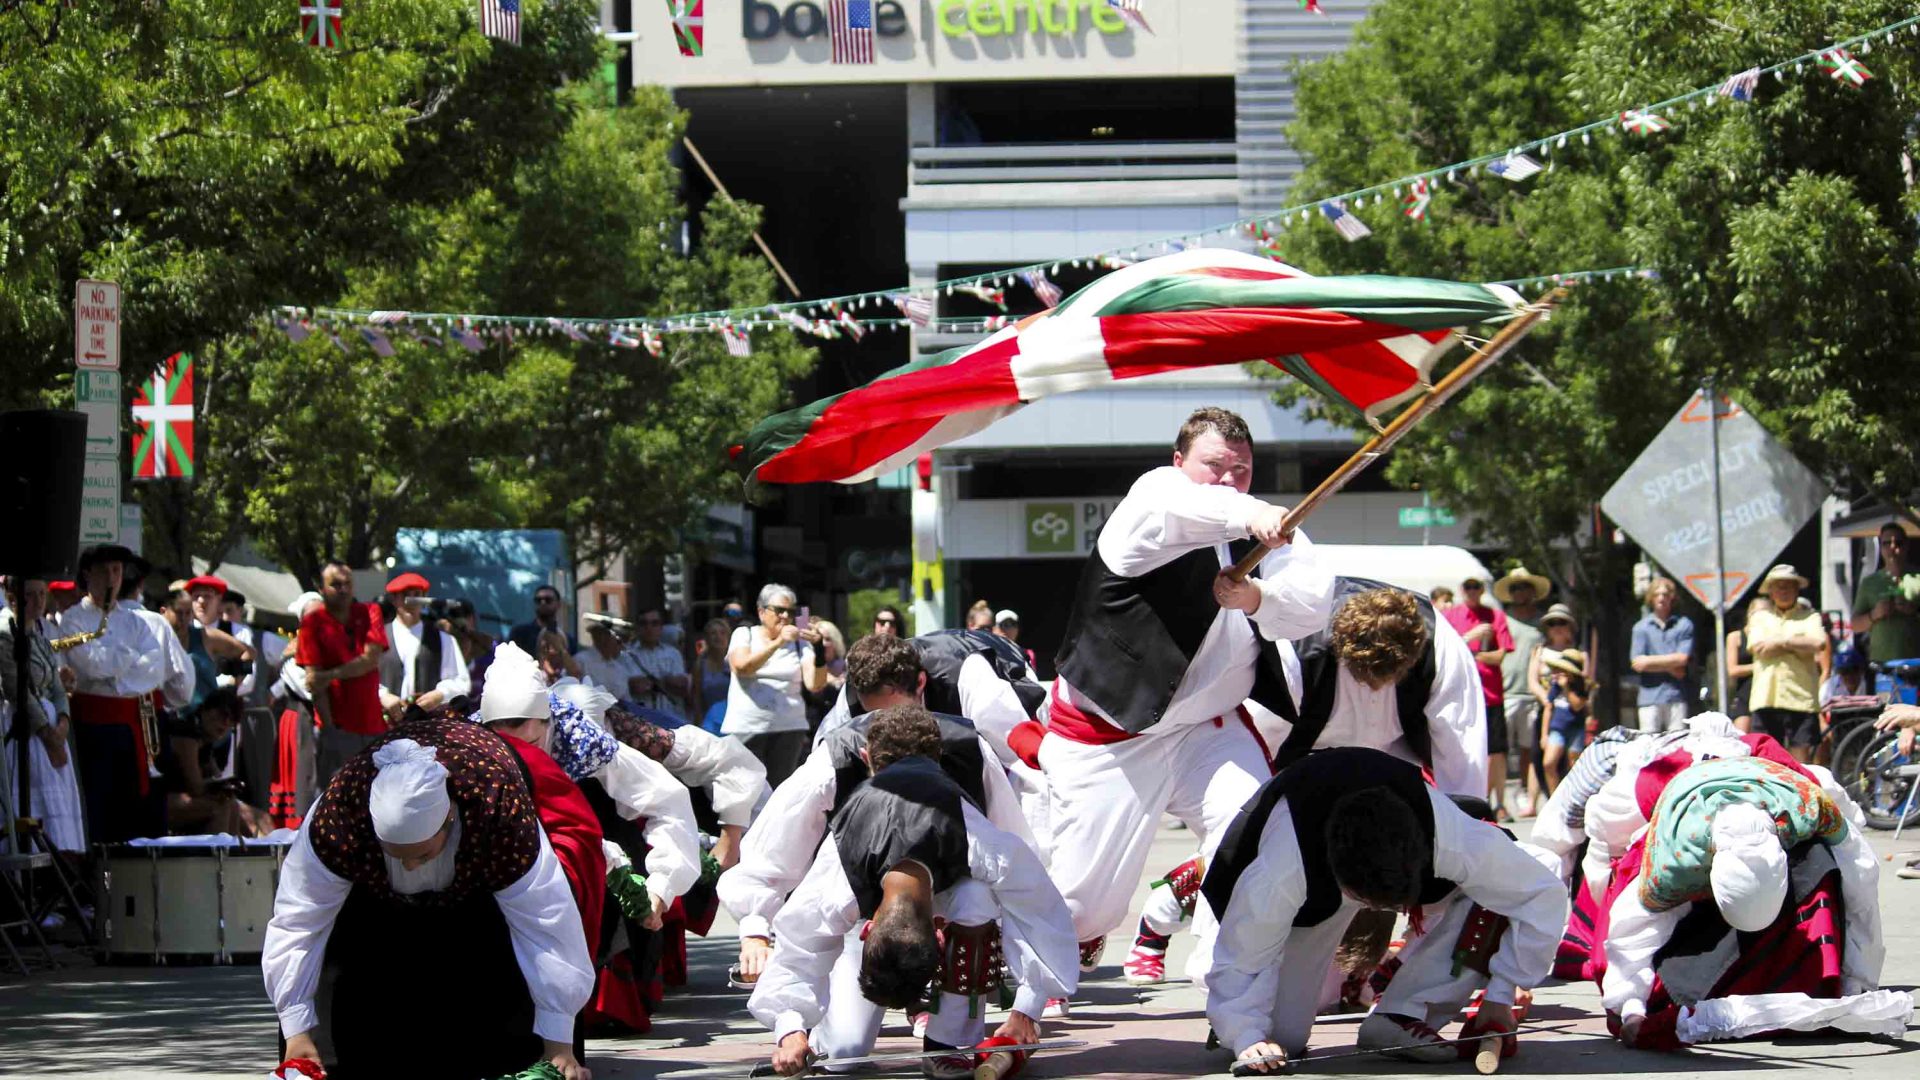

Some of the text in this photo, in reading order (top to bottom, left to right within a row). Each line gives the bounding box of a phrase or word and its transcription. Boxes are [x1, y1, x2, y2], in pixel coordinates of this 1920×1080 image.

[742, 0, 1126, 40] boe centre
[91, 289, 105, 304] NO
[80, 306, 115, 322] PARKING
[91, 323, 105, 335] ANY
[90, 337, 105, 351] TIME
[1642, 442, 1760, 505] SPECILTY
[83, 477, 115, 488] ARALLEL
[1663, 491, 1783, 554] 3226800
